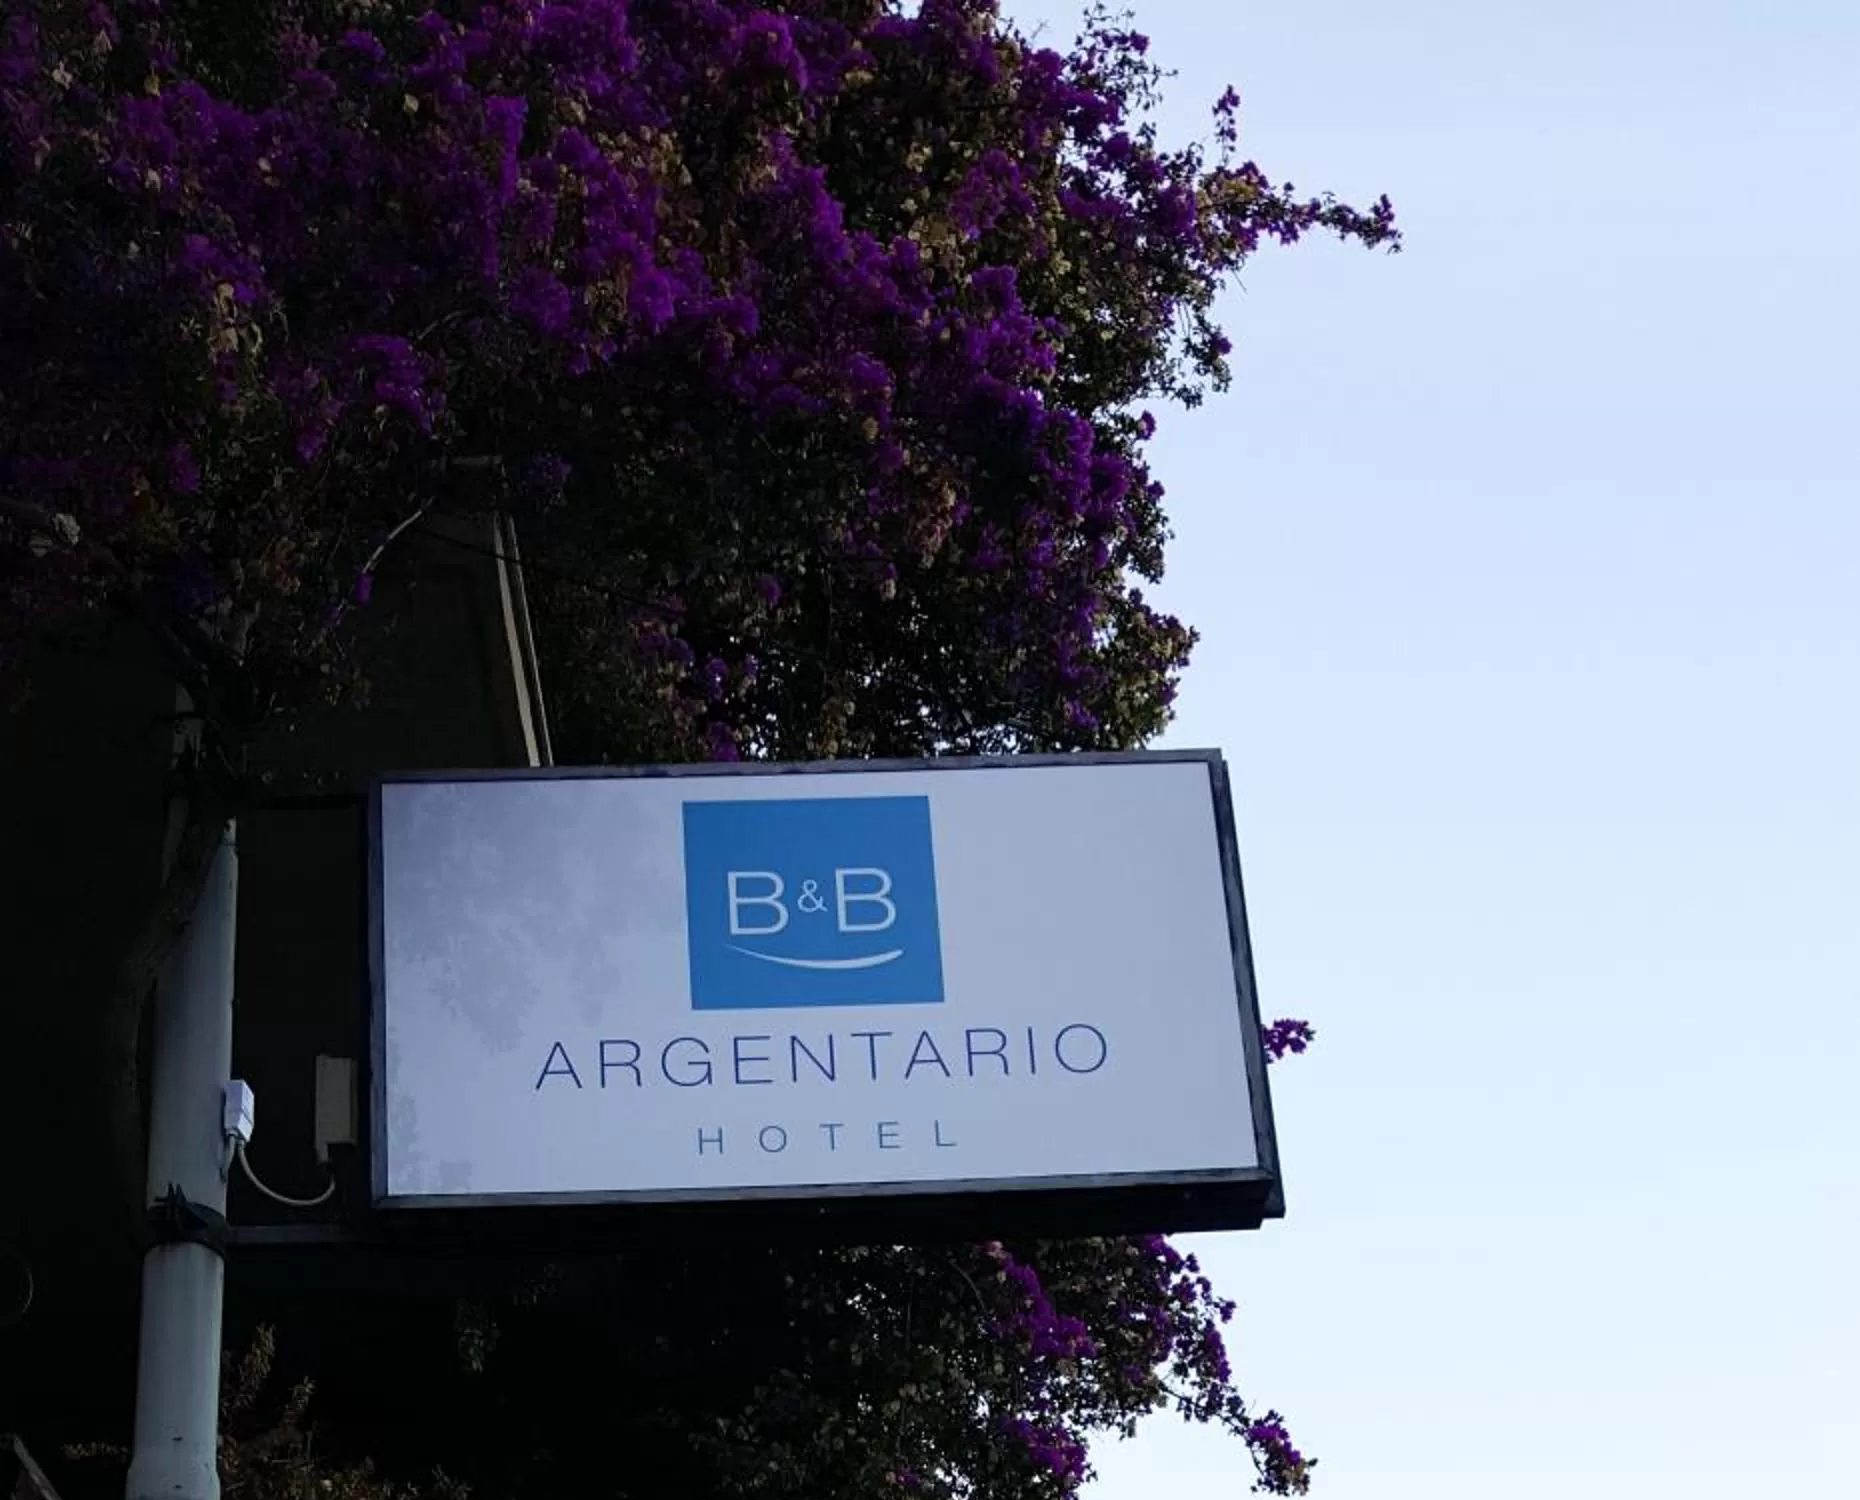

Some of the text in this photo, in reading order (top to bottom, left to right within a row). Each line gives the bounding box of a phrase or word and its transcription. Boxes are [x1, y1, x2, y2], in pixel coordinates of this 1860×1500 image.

[727, 867, 897, 935] B&B
[535, 1023, 1108, 1091] ARGENTARIO
[698, 1120, 956, 1155] HOTEL
